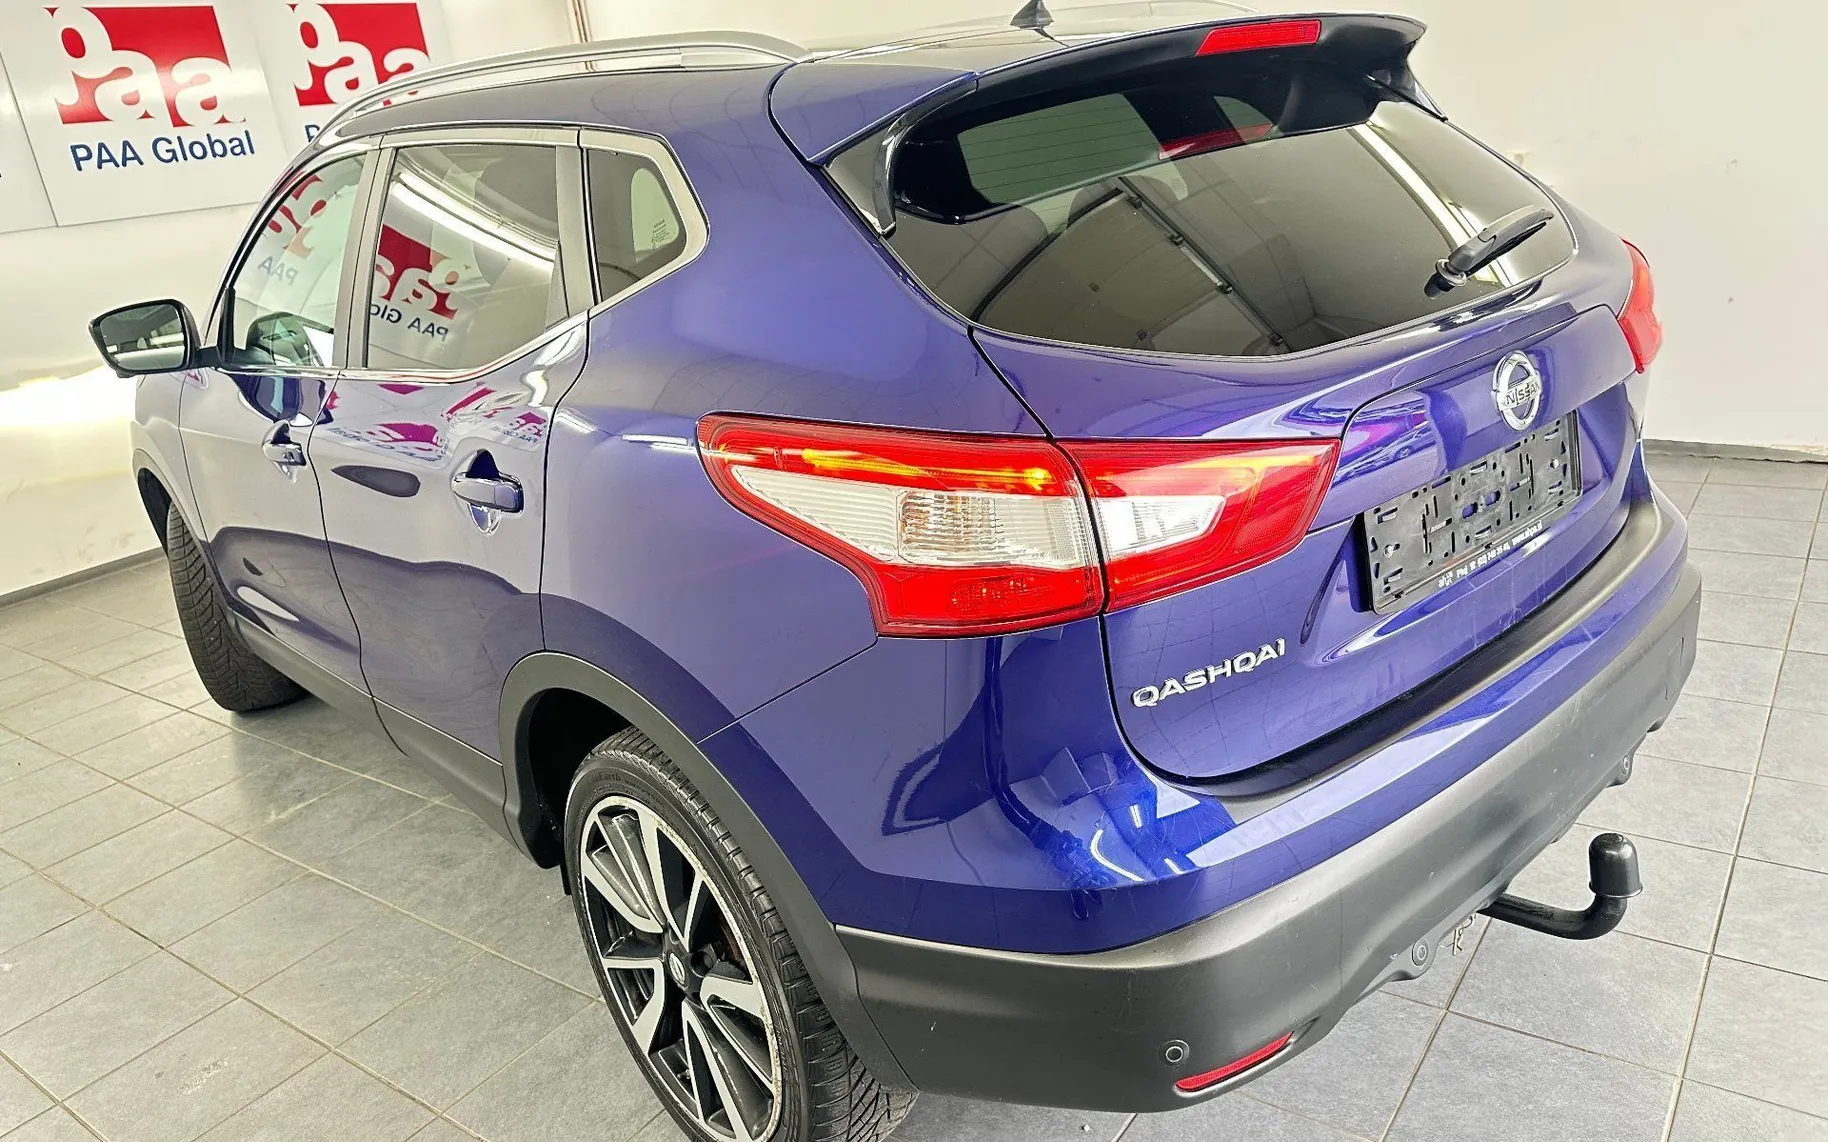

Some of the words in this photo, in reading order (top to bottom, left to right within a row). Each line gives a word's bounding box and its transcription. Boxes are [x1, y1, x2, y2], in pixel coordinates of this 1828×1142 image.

[69, 139, 144, 171] PAA
[152, 129, 255, 164] Global
[1505, 381, 1541, 405] NISSAN
[1131, 637, 1285, 707] QASHQAI
